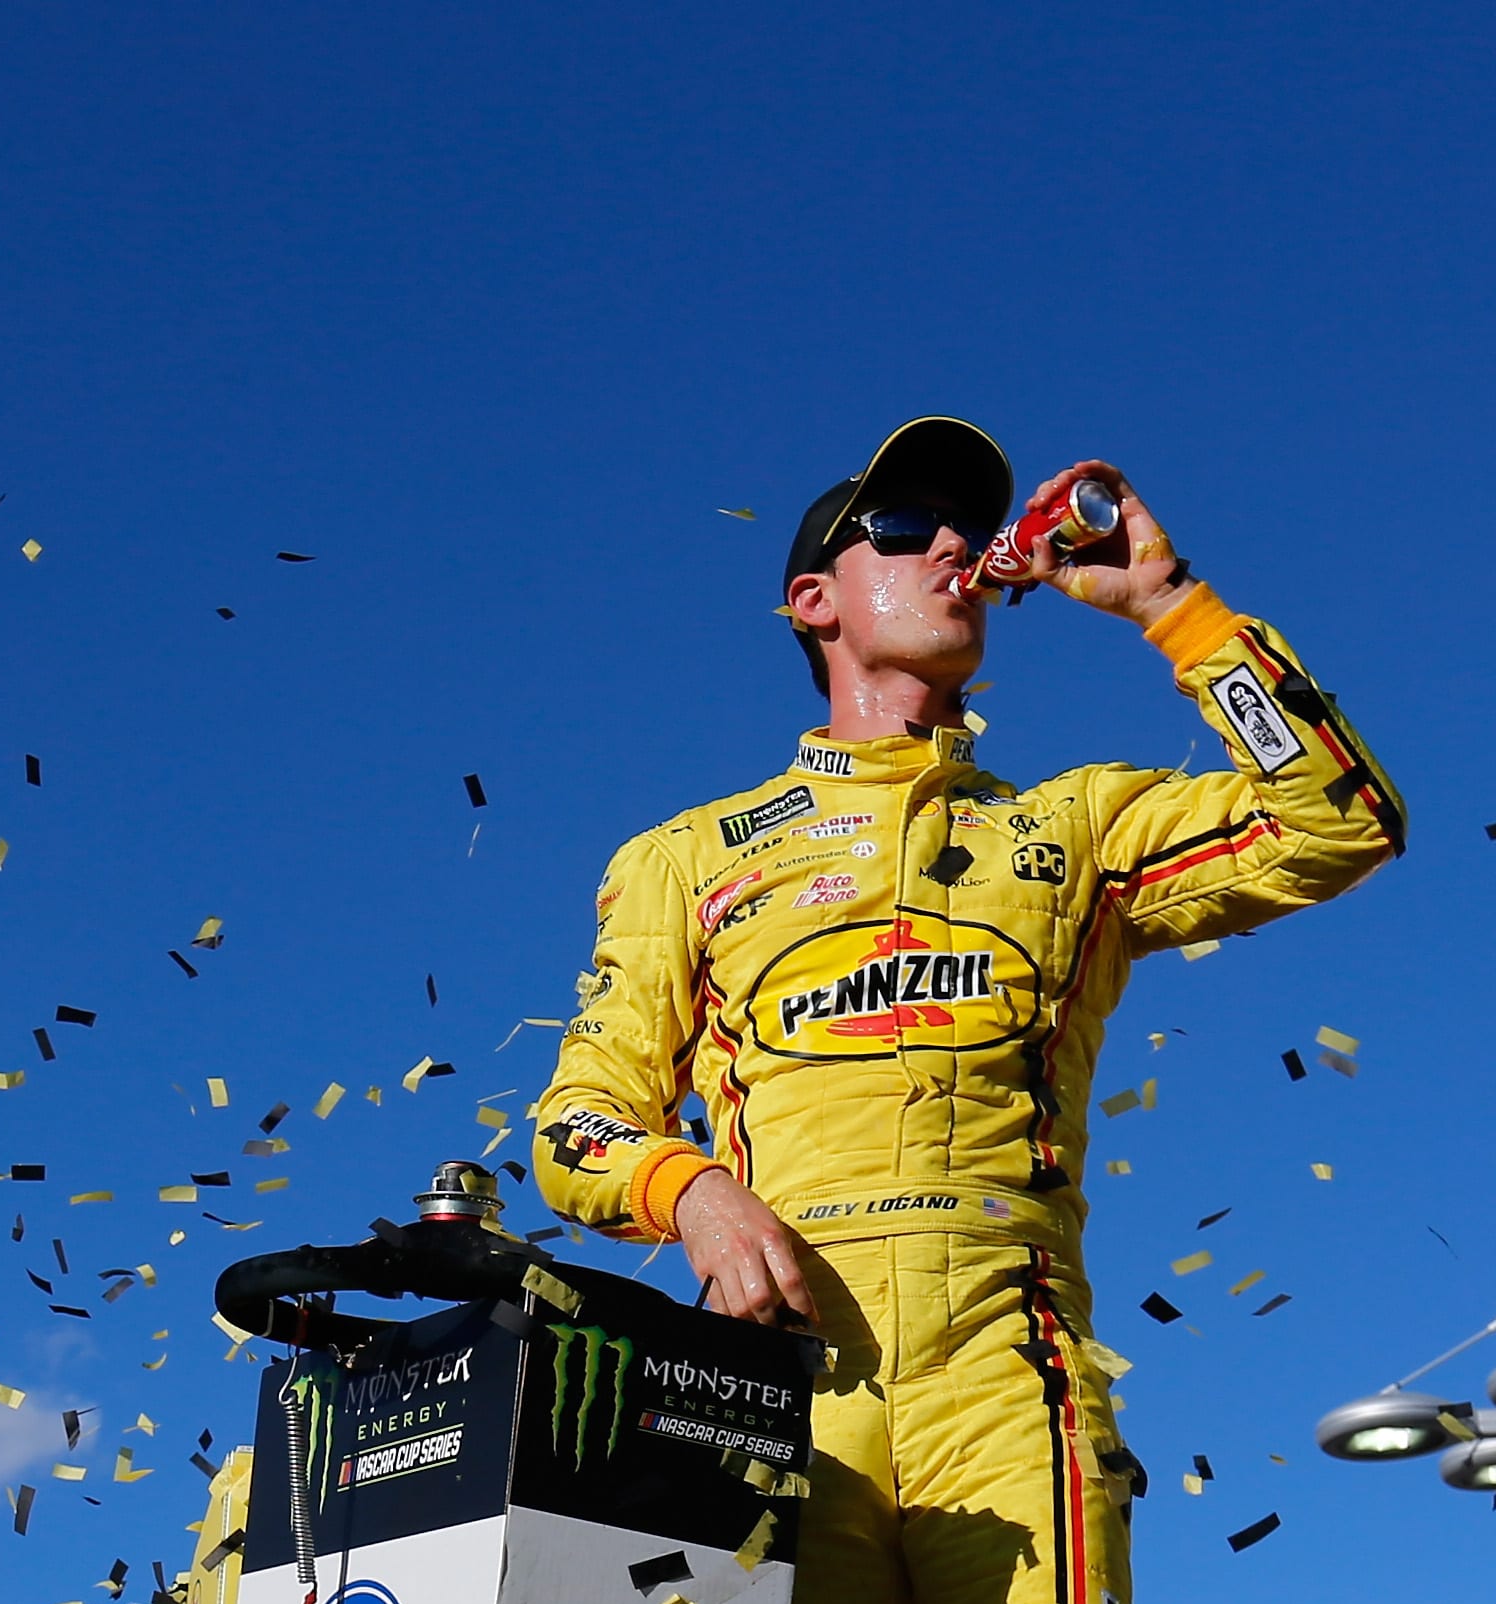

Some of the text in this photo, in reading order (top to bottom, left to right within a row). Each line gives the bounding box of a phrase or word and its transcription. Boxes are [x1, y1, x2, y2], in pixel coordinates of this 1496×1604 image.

[796, 745, 853, 776] NNZOIL
[791, 815, 873, 837] DCOUNT
[813, 824, 851, 839] TIRE
[774, 850, 848, 870] Autotrader
[1013, 845, 1065, 878] PPG
[811, 874, 854, 890] Auto
[919, 867, 991, 889] MoyLion
[798, 1196, 958, 1220] JOEY LOGANO
[358, 1401, 446, 1440] ENERGY
[665, 1395, 775, 1430] ENERGY
[397, 1440, 422, 1471] CUP
[420, 1430, 463, 1463] SERIES
[657, 1416, 795, 1460] NASCAR CUP SERIES
